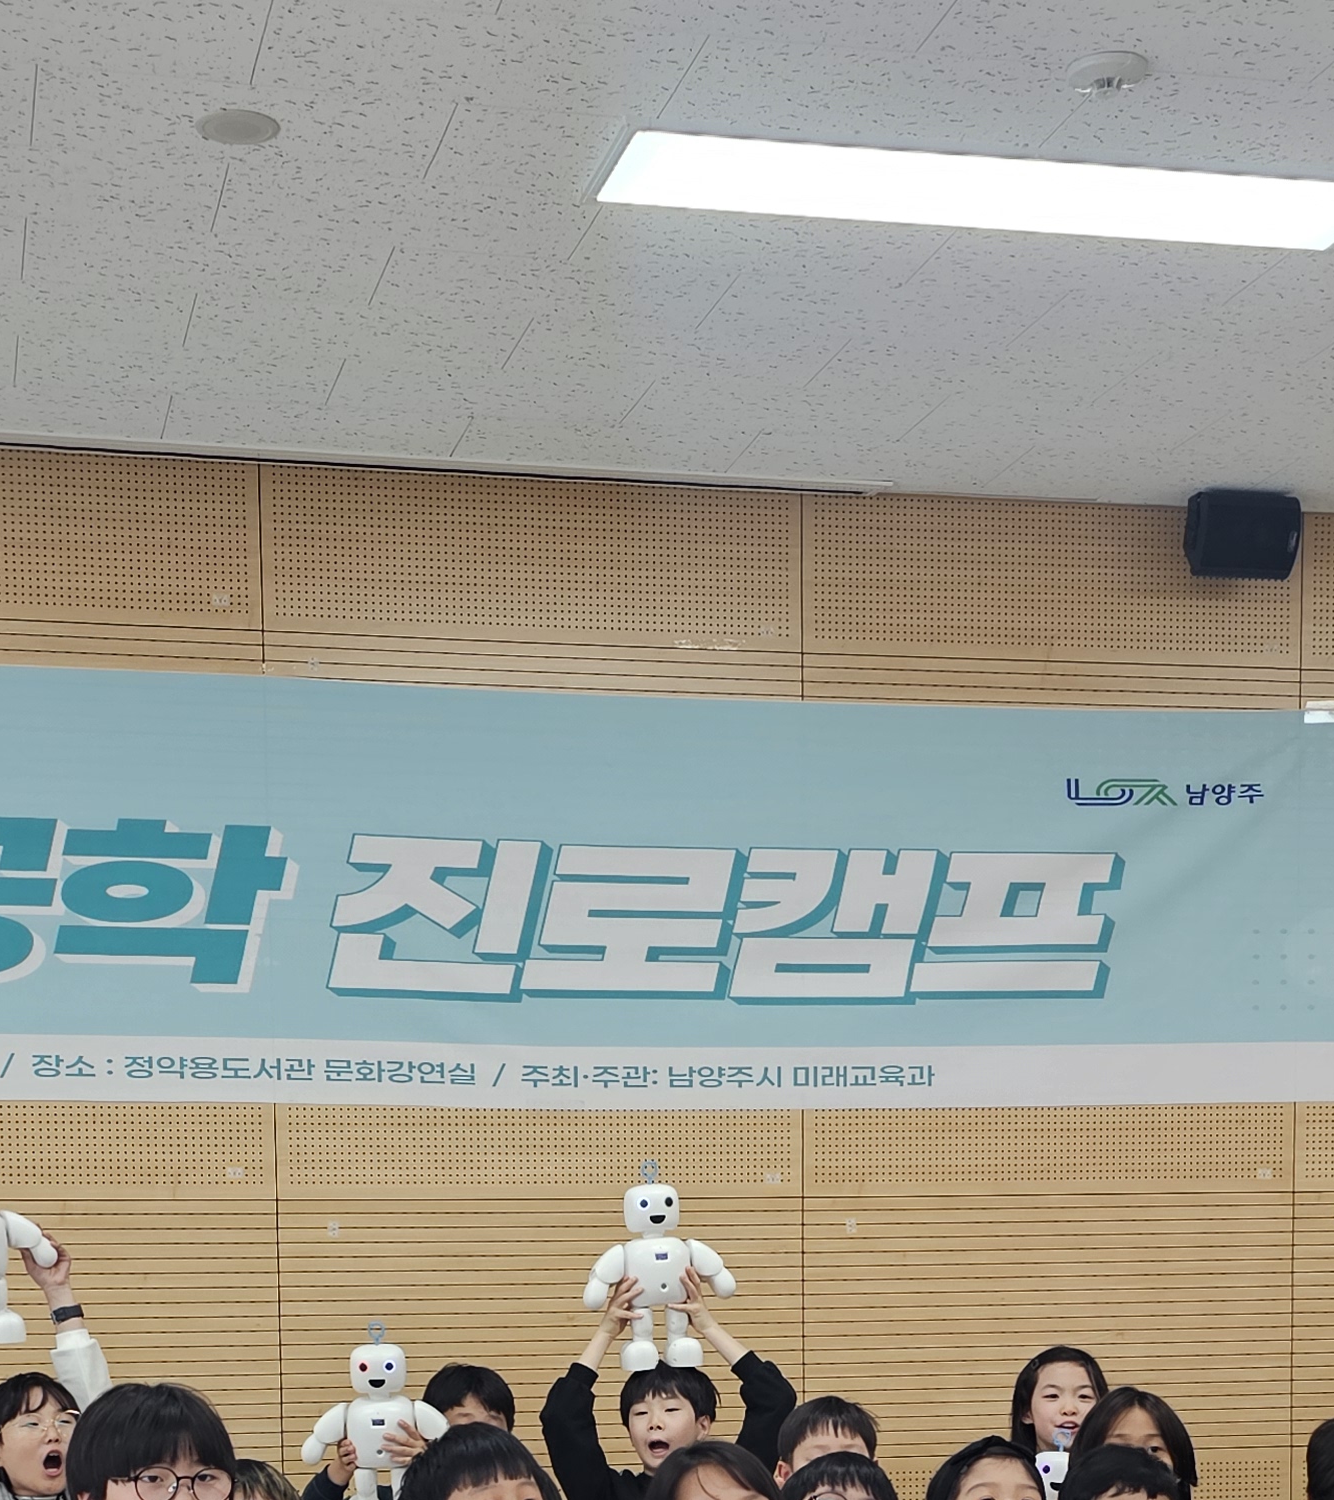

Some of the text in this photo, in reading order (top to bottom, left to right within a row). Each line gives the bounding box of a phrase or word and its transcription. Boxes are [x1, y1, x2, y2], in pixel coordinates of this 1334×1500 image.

[1185, 782, 1265, 807] 남양주
[326, 832, 1125, 1005] 진로캠프
[31, 1053, 97, 1079] 장소
[123, 1055, 317, 1082] 정약용도서관
[323, 1058, 478, 1086] 문화강연실
[667, 1065, 783, 1089] 남양주시
[792, 1064, 936, 1089] 미래교육과
